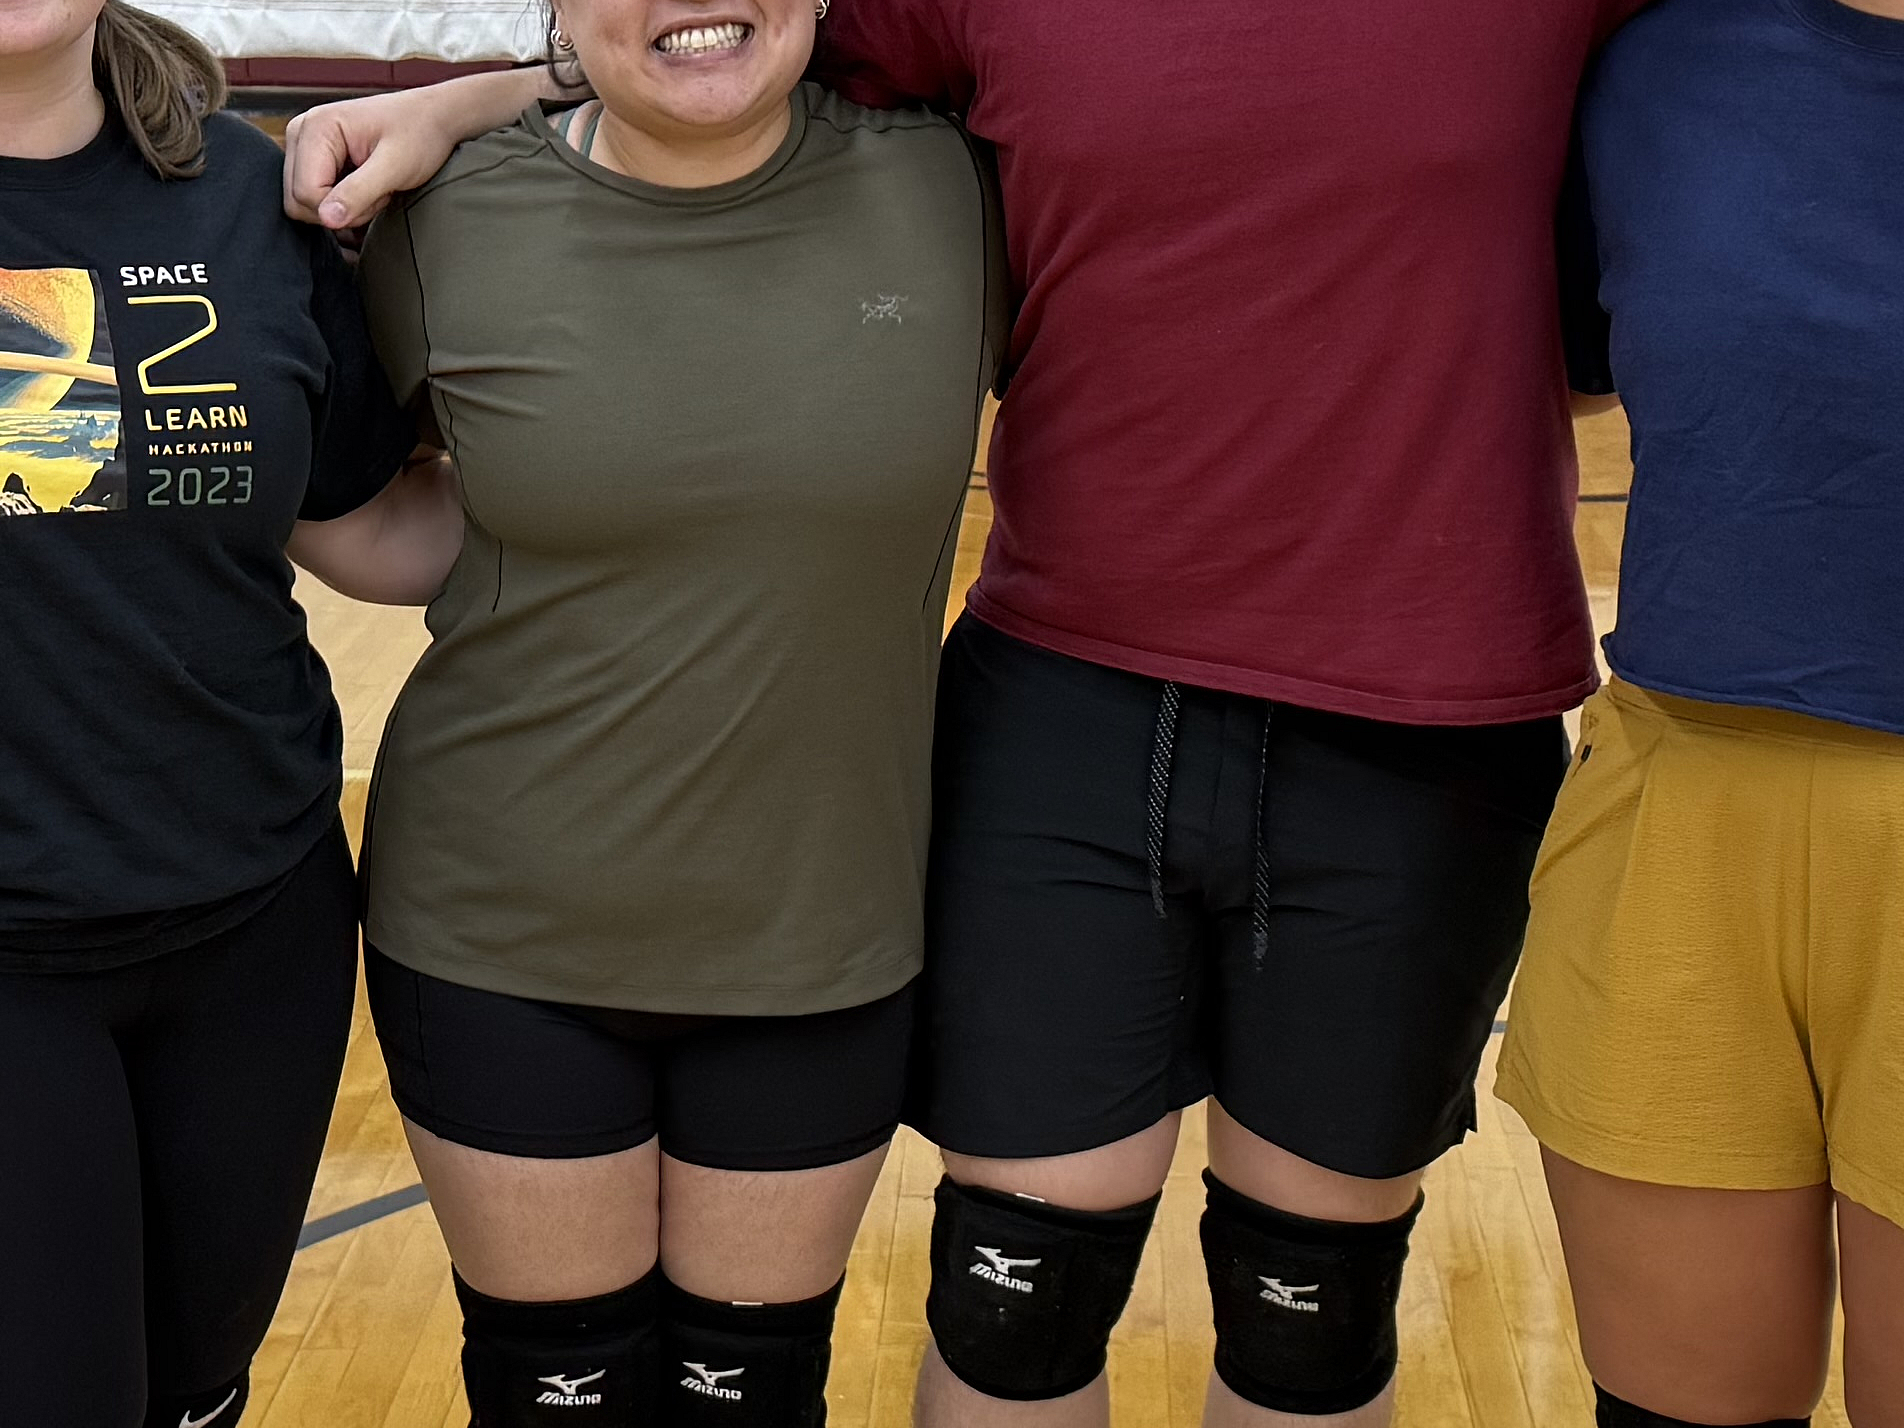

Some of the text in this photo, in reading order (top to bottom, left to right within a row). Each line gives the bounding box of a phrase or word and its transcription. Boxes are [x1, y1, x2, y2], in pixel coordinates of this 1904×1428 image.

[119, 263, 208, 286] SPACE
[127, 294, 237, 395] 2
[145, 405, 248, 431] LEARN
[148, 440, 253, 456] HACKATHON
[147, 465, 253, 506] 2023
